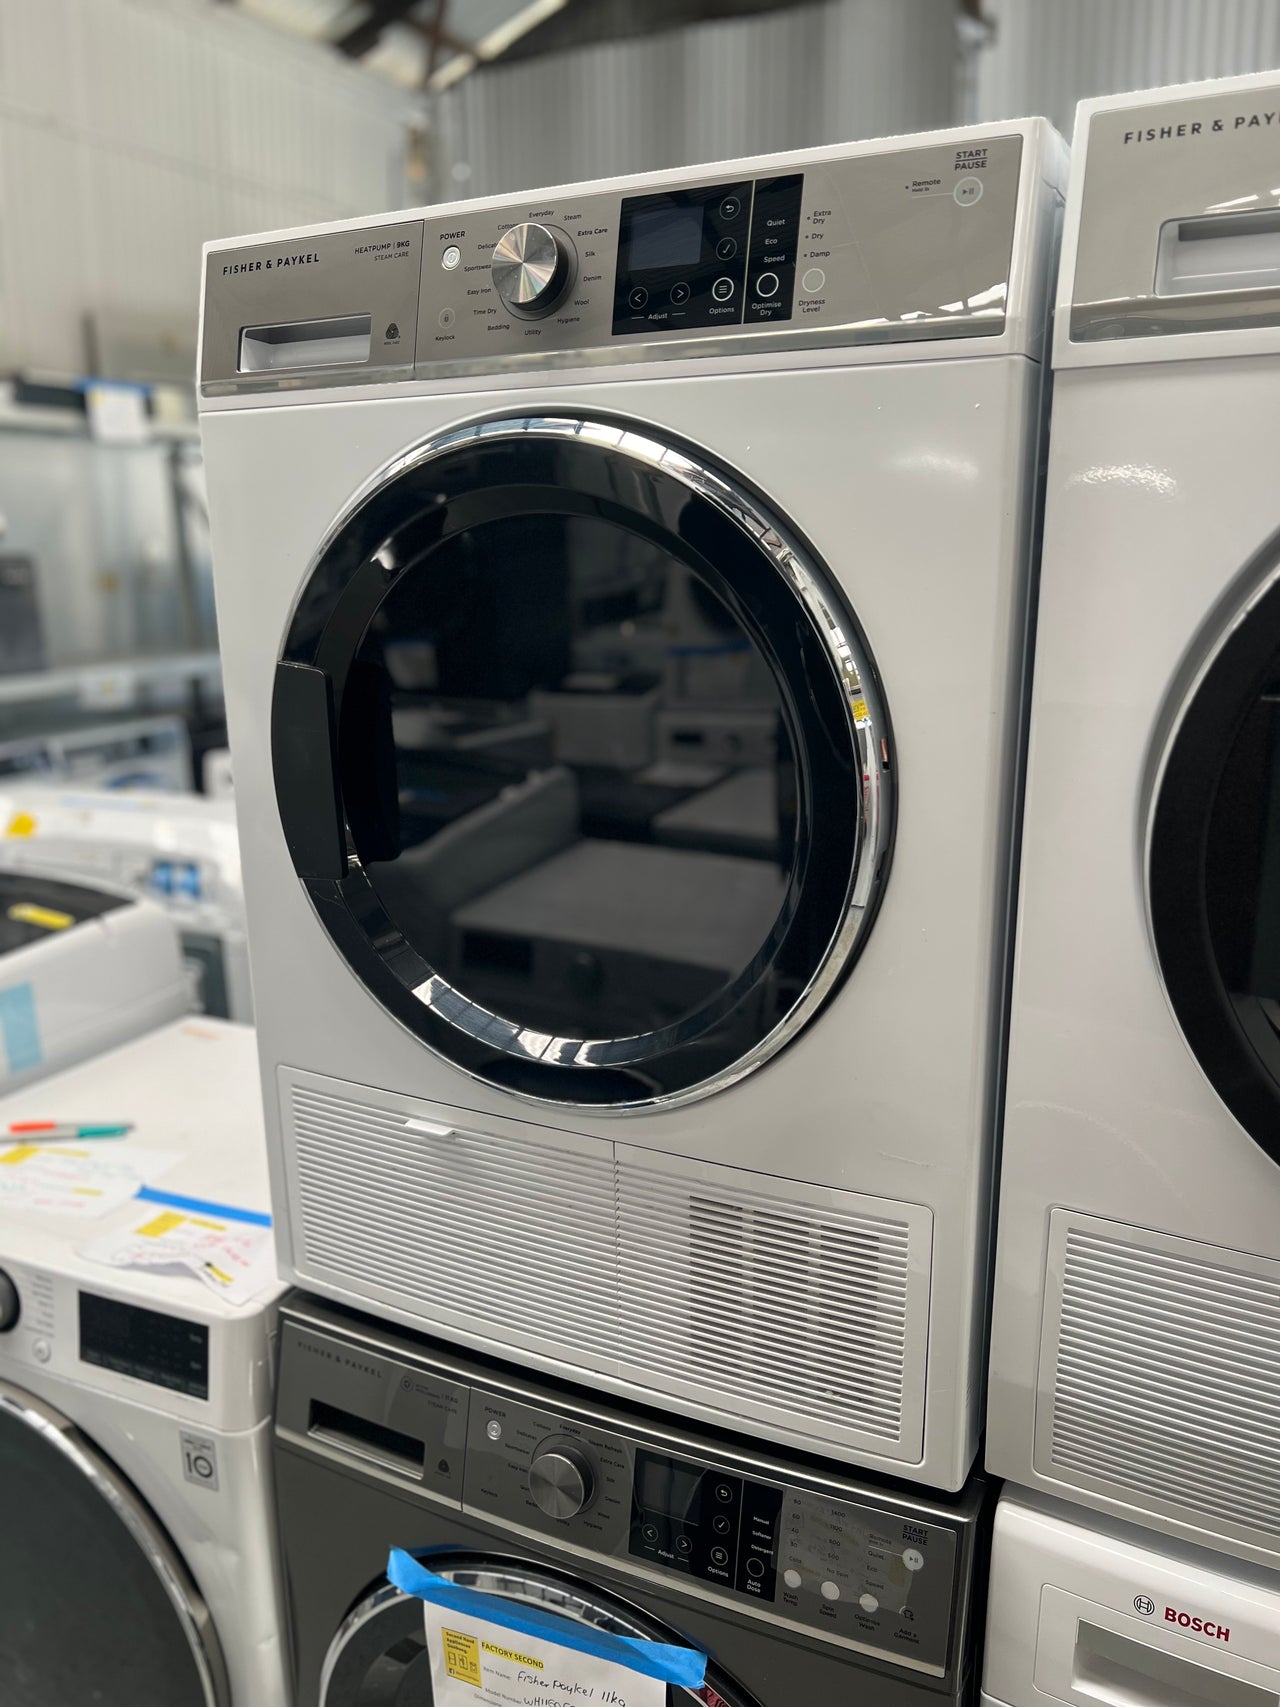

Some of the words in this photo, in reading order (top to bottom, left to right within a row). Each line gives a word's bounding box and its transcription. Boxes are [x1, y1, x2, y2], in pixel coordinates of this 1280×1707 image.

[1124, 122, 1202, 144] FISHER
[1211, 119, 1224, 132] &
[1234, 111, 1280, 129] PAY
[956, 148, 988, 159] START
[954, 160, 987, 171] PAUSE
[912, 179, 941, 187] Remote
[529, 210, 554, 218] Everyday
[766, 218, 786, 227] Quiet
[813, 217, 826, 225] Dry
[440, 231, 466, 240] POWER
[577, 229, 593, 237] Extra
[594, 227, 608, 235] Care
[811, 232, 824, 240] Dry
[765, 237, 778, 245] Eco
[354, 243, 391, 254] HEATPUMP
[396, 240, 410, 249] 9KG
[374, 253, 393, 261] STEAM
[393, 251, 409, 259] CARE
[763, 254, 785, 263] Speed
[810, 250, 830, 259] Damp
[223, 262, 262, 275] FISHER
[266, 260, 273, 269] &
[277, 253, 320, 267] PAYKEL
[464, 264, 492, 272] Sportswea
[583, 274, 602, 282] Denim
[467, 288, 479, 297] Easy
[480, 287, 492, 295] Iron
[751, 301, 782, 310] Optimise
[798, 299, 826, 307] Dryness
[486, 308, 497, 316] Dry
[709, 306, 735, 315] Options
[759, 309, 772, 317] Dry
[557, 316, 580, 325] Hygiene
[648, 312, 668, 321] Adjust
[487, 323, 510, 332] Bedding
[524, 329, 542, 337] Utility
[435, 334, 455, 342] Keylock
[298, 1341, 332, 1359] FISHER
[345, 1359, 382, 1378] PAYKEL
[484, 1406, 506, 1418] POWER
[831, 1509, 846, 1518] 1400
[753, 1516, 769, 1525] Manual
[903, 1524, 928, 1536] START
[752, 1530, 772, 1540] Softener
[869, 1533, 892, 1545] Remote
[902, 1533, 928, 1546] PAUSE
[657, 1550, 674, 1560] Adjust
[868, 1550, 884, 1560] Quiet
[707, 1566, 729, 1578] Options
[866, 1565, 878, 1573] Eco
[747, 1579, 761, 1587] Auto
[865, 1580, 884, 1590] Speed
[746, 1584, 761, 1593] Dose
[783, 1591, 799, 1601] Wash
[783, 1597, 798, 1607] Temp
[822, 1603, 835, 1612] Spin
[819, 1608, 837, 1619] Speed
[854, 1614, 881, 1626] Optimise
[1164, 1607, 1230, 1642] BOSCH
[859, 1621, 875, 1631] Wash
[899, 1627, 912, 1636] Add
[463, 1635, 474, 1644] Hand
[894, 1632, 920, 1644] Garment
[481, 1641, 513, 1658] FACTORY
[514, 1653, 544, 1669] SECOND
[517, 1670, 549, 1688] Fisher
